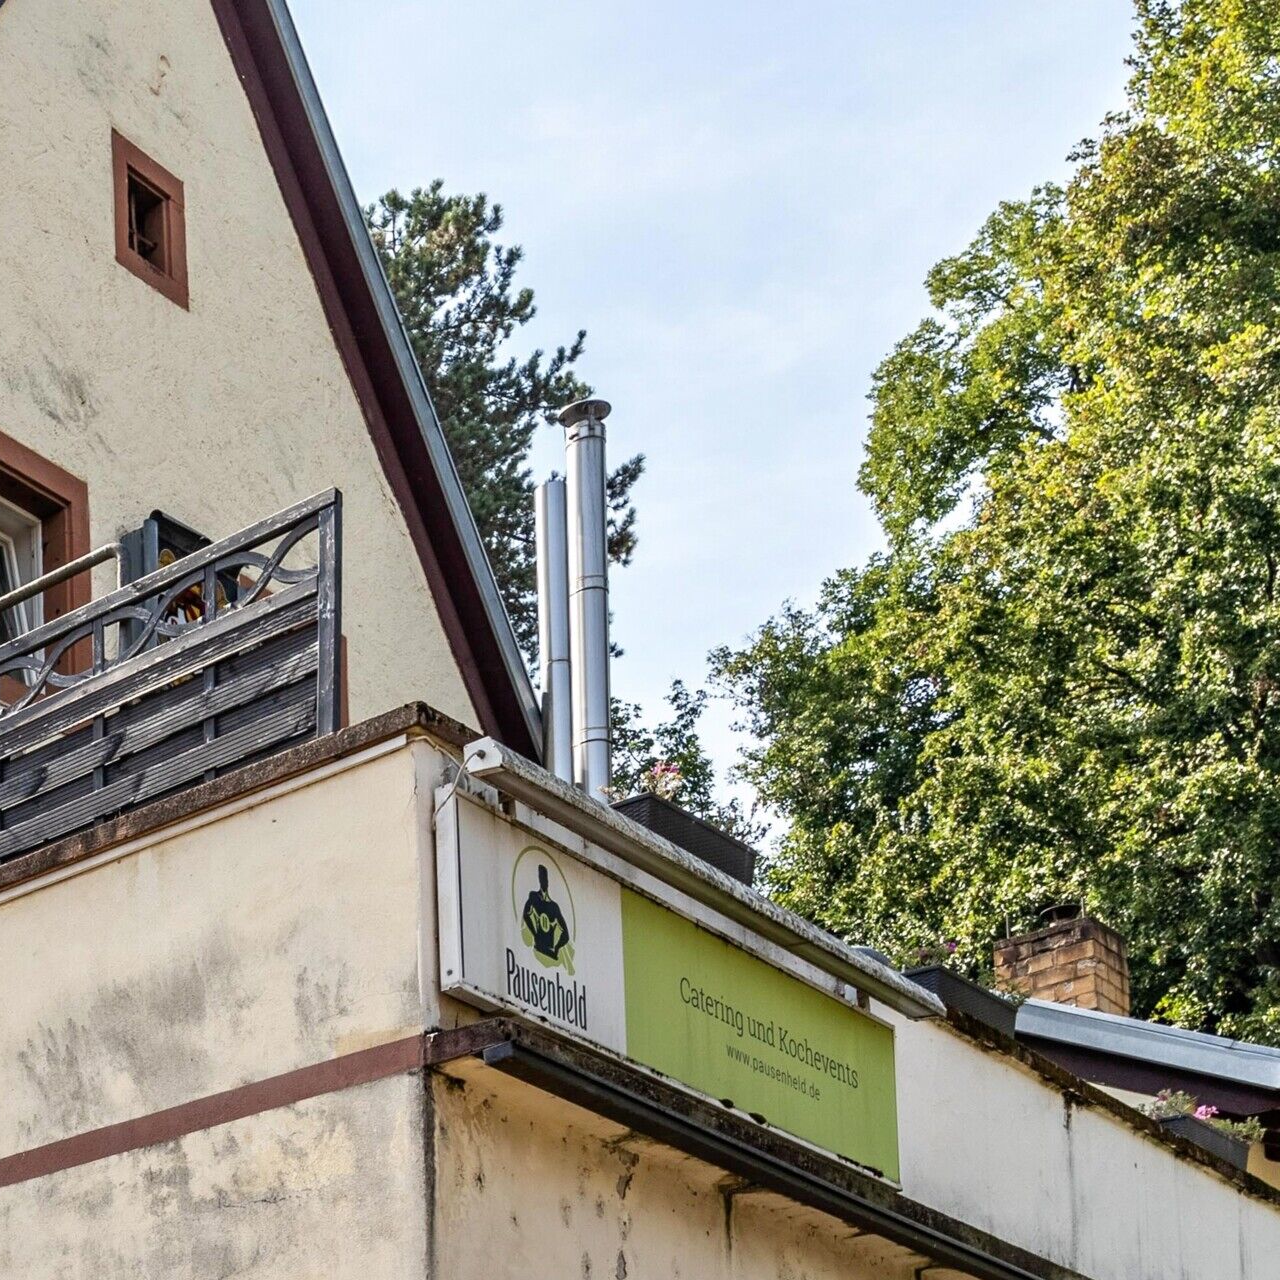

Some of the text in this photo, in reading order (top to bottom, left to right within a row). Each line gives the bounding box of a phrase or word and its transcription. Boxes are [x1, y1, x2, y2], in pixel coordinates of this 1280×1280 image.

[506, 947, 587, 1031] Pausenheld
[680, 977, 859, 1089] Catering und Kochevents
[726, 1043, 821, 1101] www.pausenheld.de
